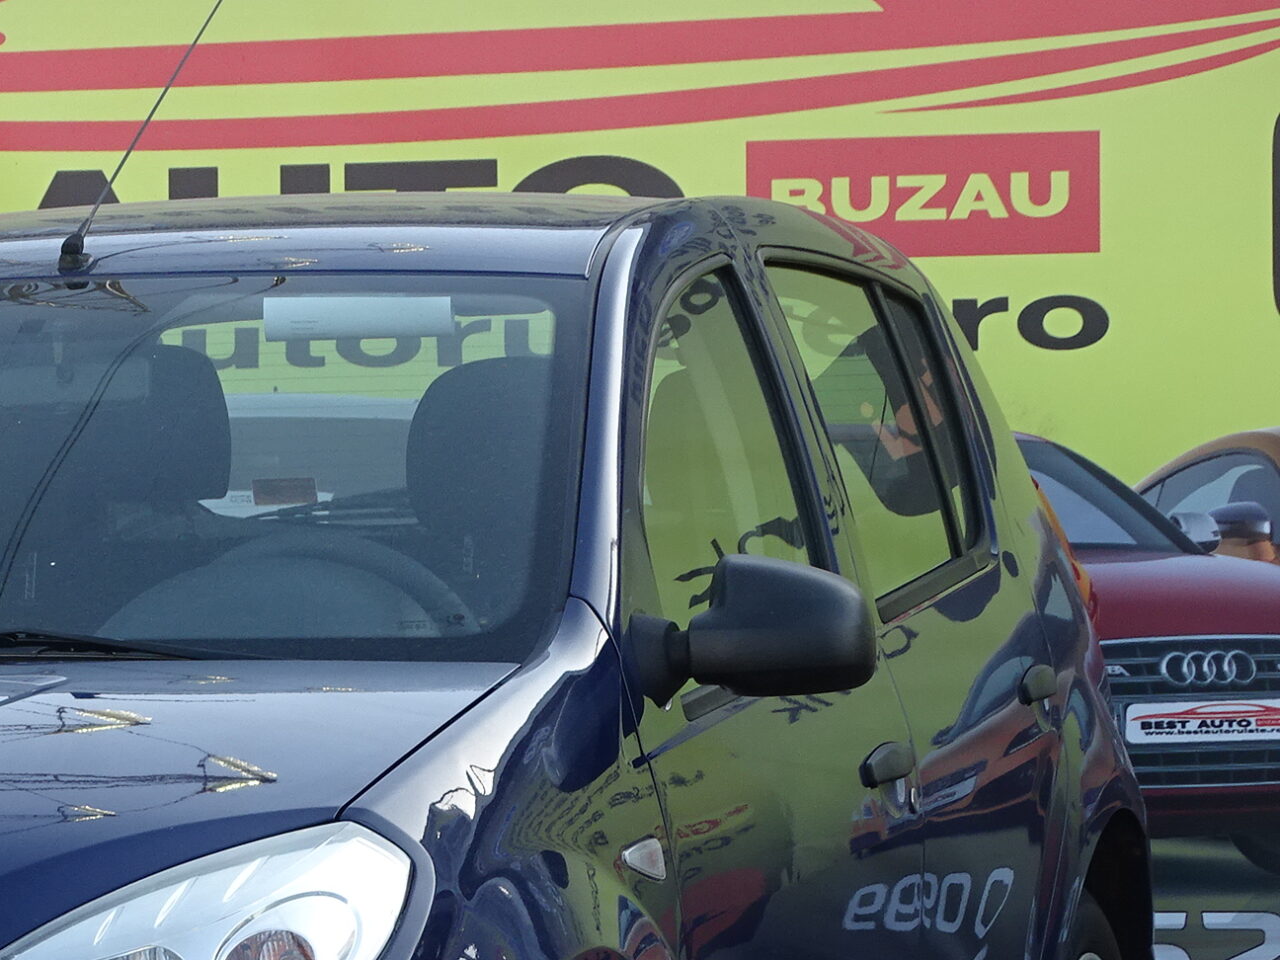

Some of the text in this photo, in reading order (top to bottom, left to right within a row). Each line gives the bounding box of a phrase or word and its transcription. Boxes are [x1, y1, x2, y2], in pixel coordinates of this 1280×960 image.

[771, 171, 1070, 224] BUZAU
[1140, 720, 1190, 730] BEST
[1197, 719, 1251, 729] AUTO
